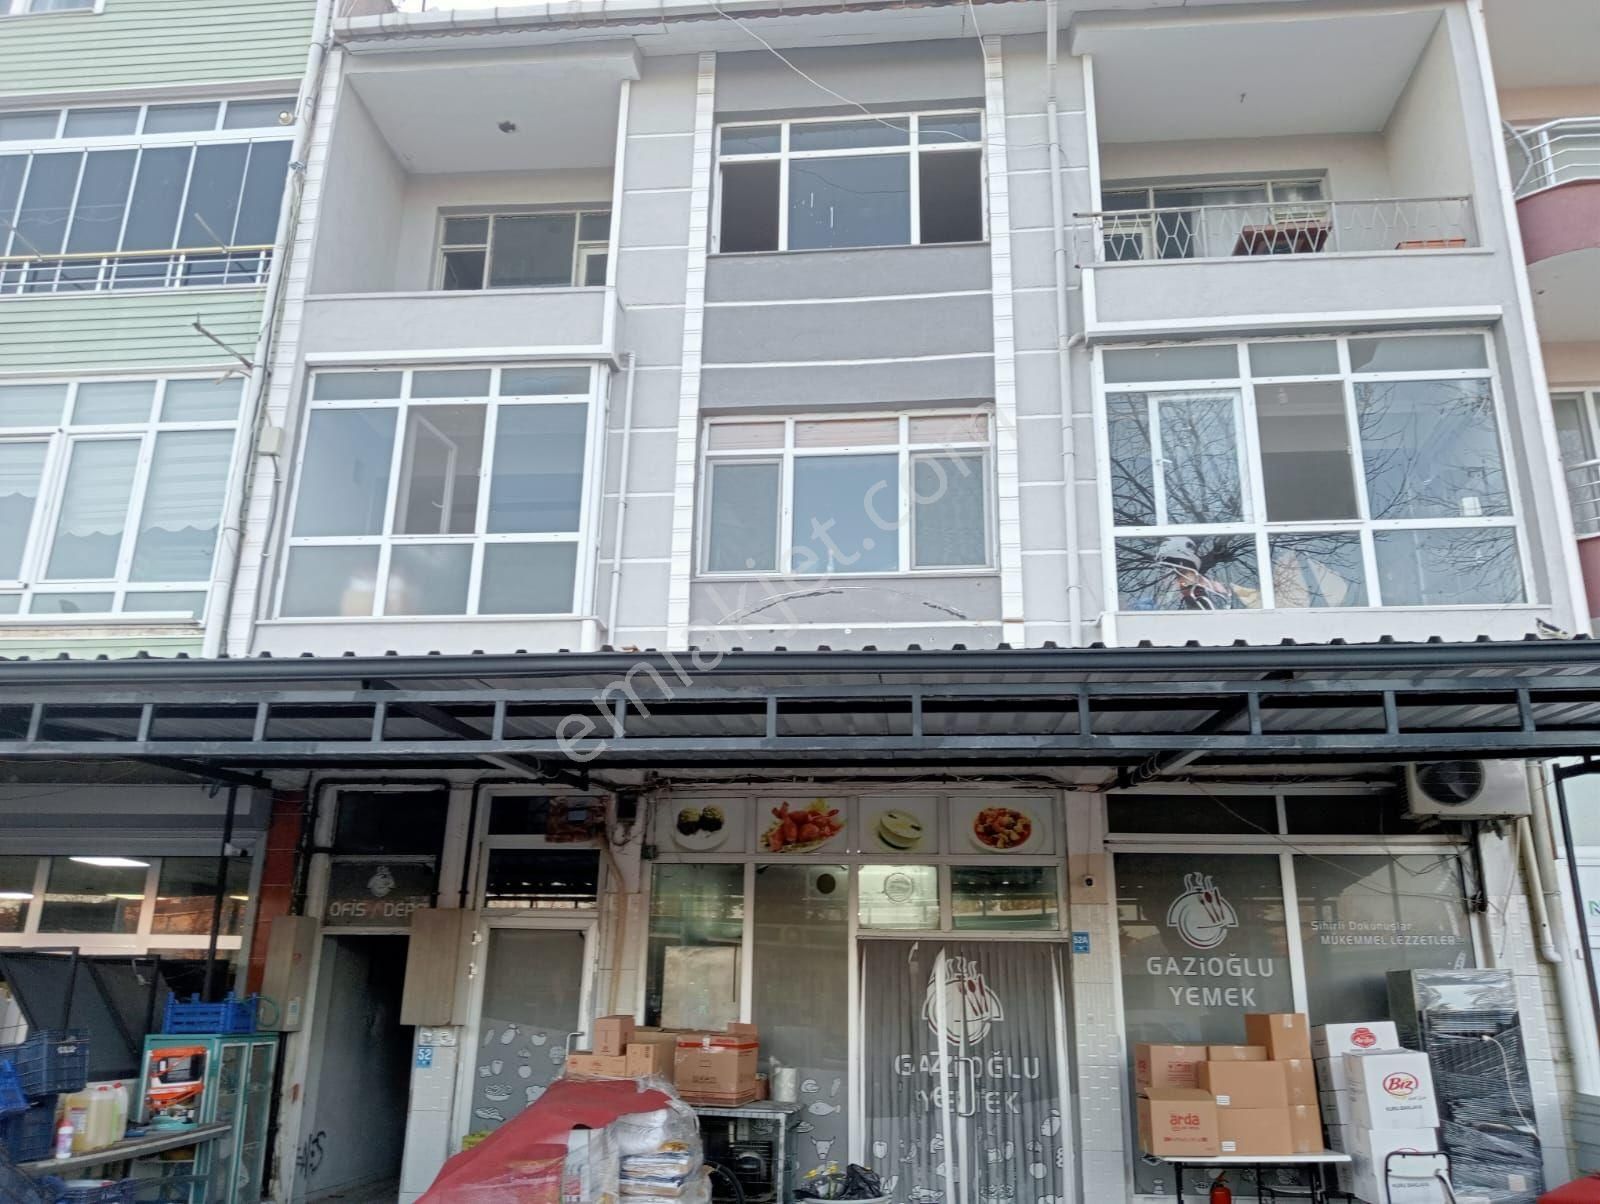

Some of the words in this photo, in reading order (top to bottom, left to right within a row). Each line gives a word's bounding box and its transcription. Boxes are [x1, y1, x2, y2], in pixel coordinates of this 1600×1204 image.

[384, 902, 426, 917] DEP
[1168, 986, 1256, 1007] YEMEK
[418, 1048, 432, 1060] 52
[1169, 1113, 1200, 1126] arda
